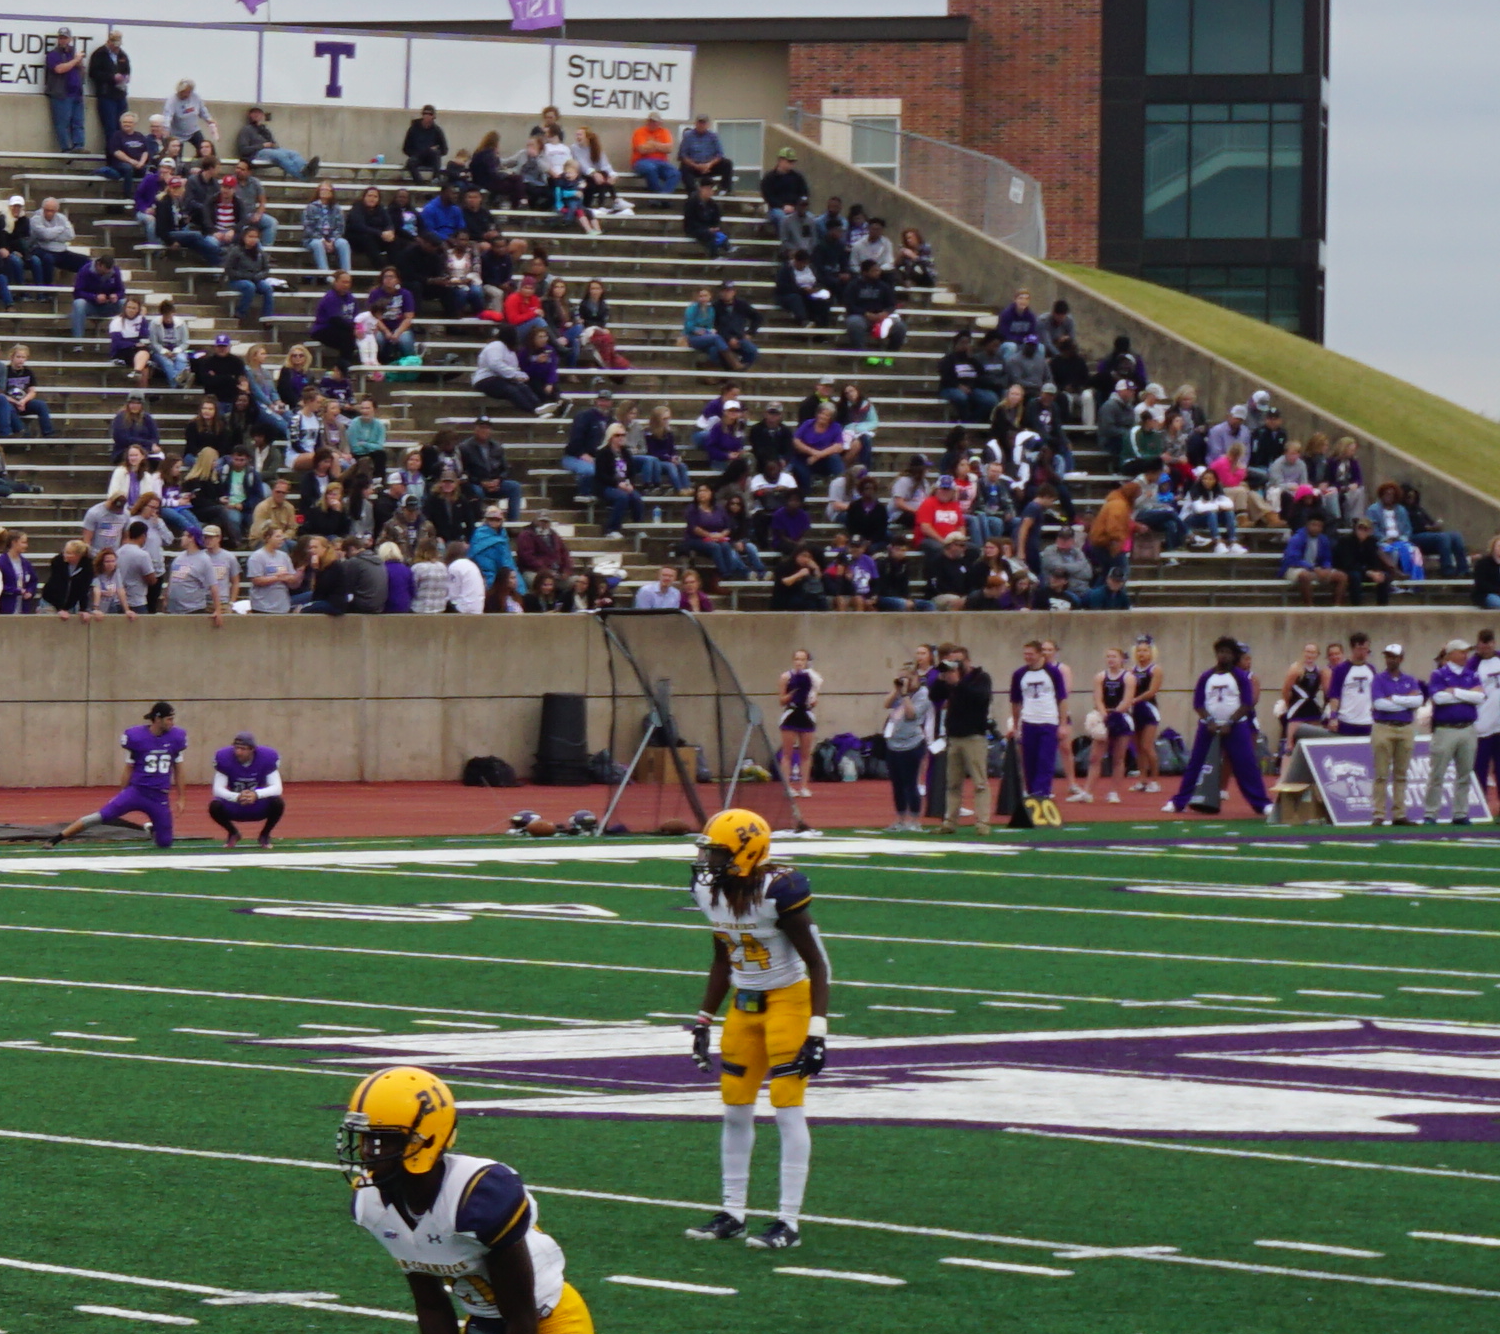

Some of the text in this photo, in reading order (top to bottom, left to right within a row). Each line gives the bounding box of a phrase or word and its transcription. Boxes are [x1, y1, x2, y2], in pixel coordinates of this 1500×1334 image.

[315, 41, 356, 98] T
[567, 54, 677, 82] STUDENT
[572, 83, 670, 111] SEATING
[1025, 798, 1062, 827] 20
[735, 822, 760, 841] 24
[415, 1085, 448, 1116] 21
